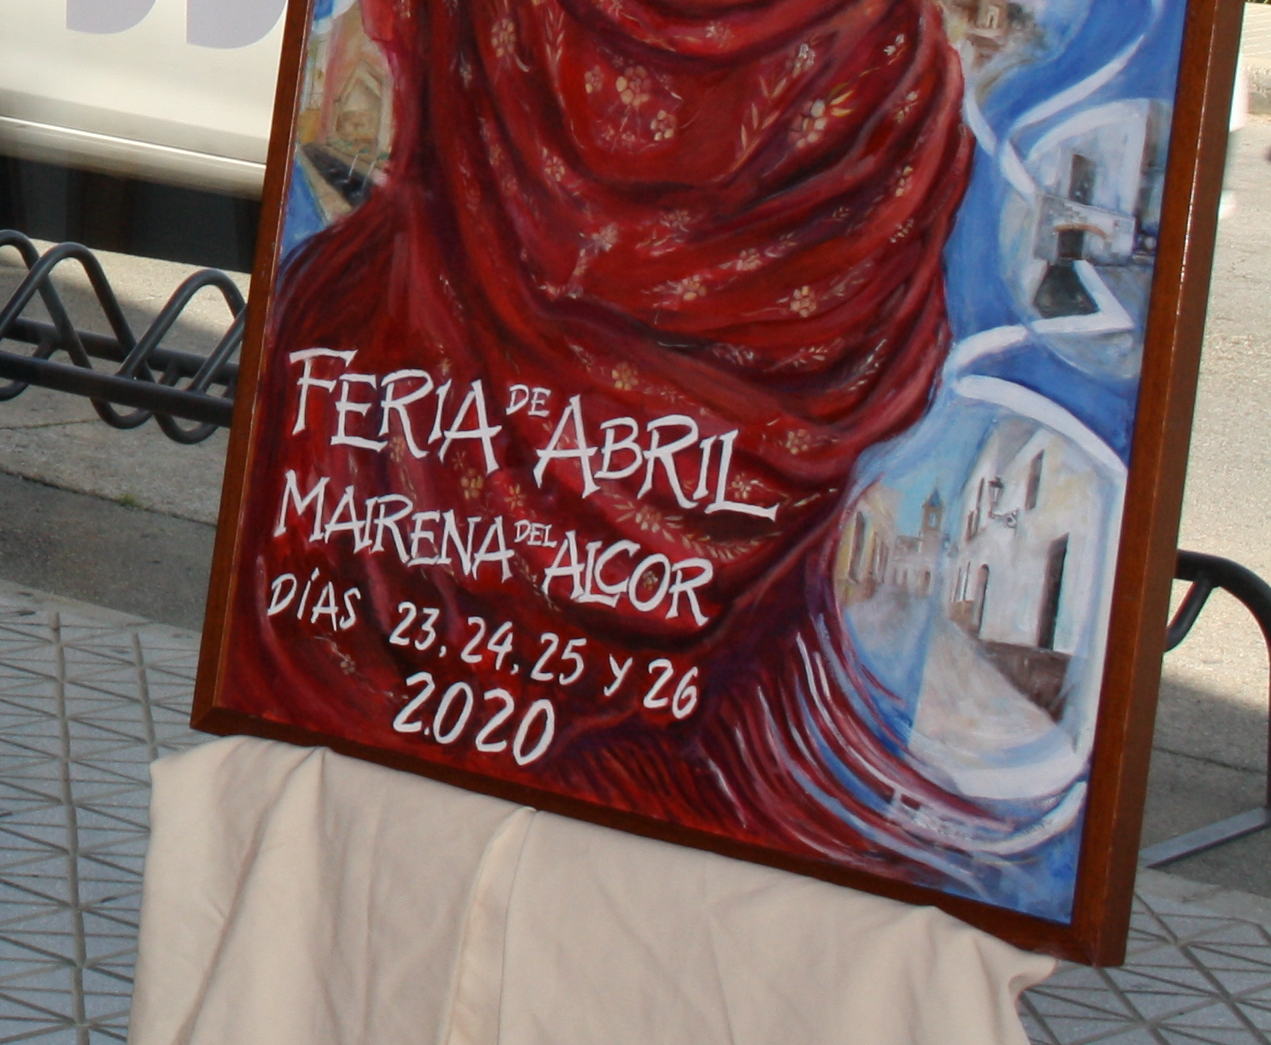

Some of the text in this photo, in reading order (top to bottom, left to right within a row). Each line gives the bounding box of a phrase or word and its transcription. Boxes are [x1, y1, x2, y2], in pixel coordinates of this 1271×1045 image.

[289, 348, 778, 522] FERIA DE ABRIL
[273, 469, 714, 627] MAIRENA DEL ALCOR
[267, 572, 363, 632] DÍAS
[539, 633, 588, 687] 25
[642, 659, 700, 720] 26
